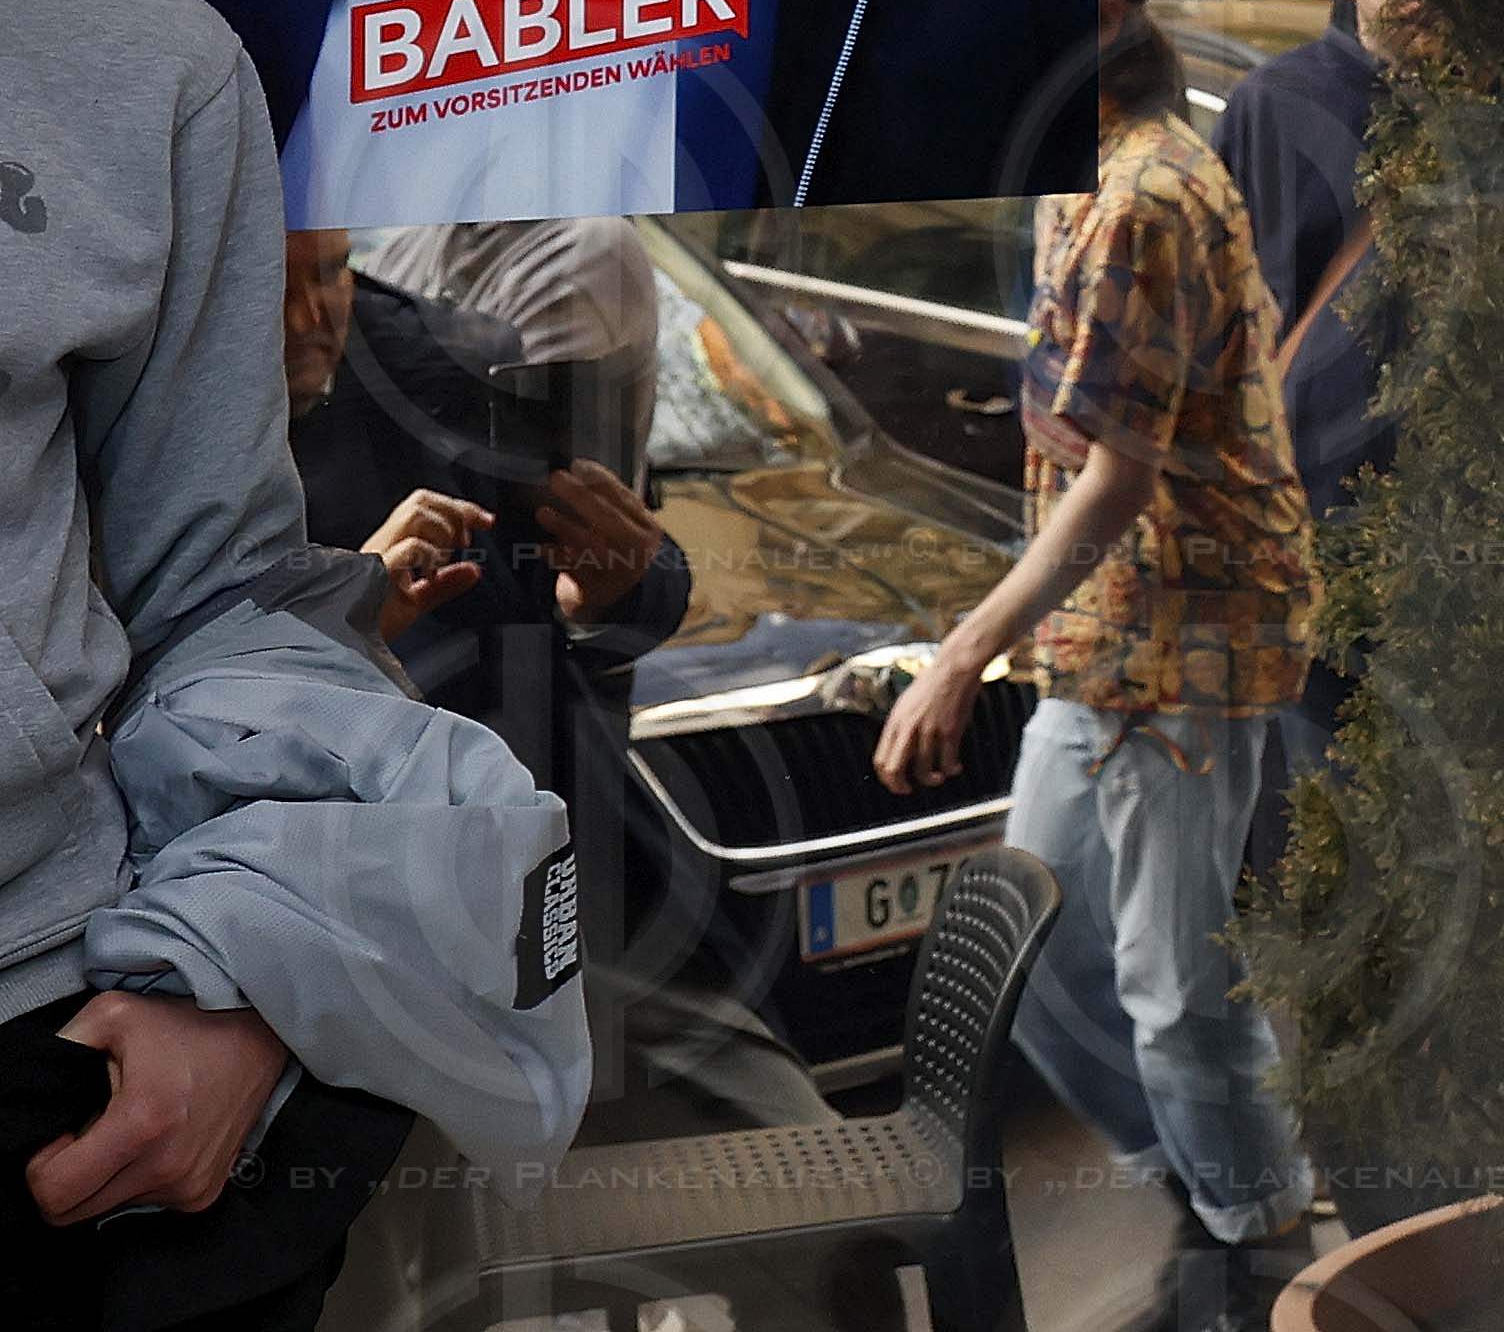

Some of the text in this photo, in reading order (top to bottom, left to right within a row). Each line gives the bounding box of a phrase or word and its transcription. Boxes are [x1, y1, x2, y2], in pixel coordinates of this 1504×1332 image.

[370, 43, 732, 133] ZUM VORSITZENDEN WÄHLEN
[557, 852, 578, 970] URBAN
[865, 876, 890, 929] G
